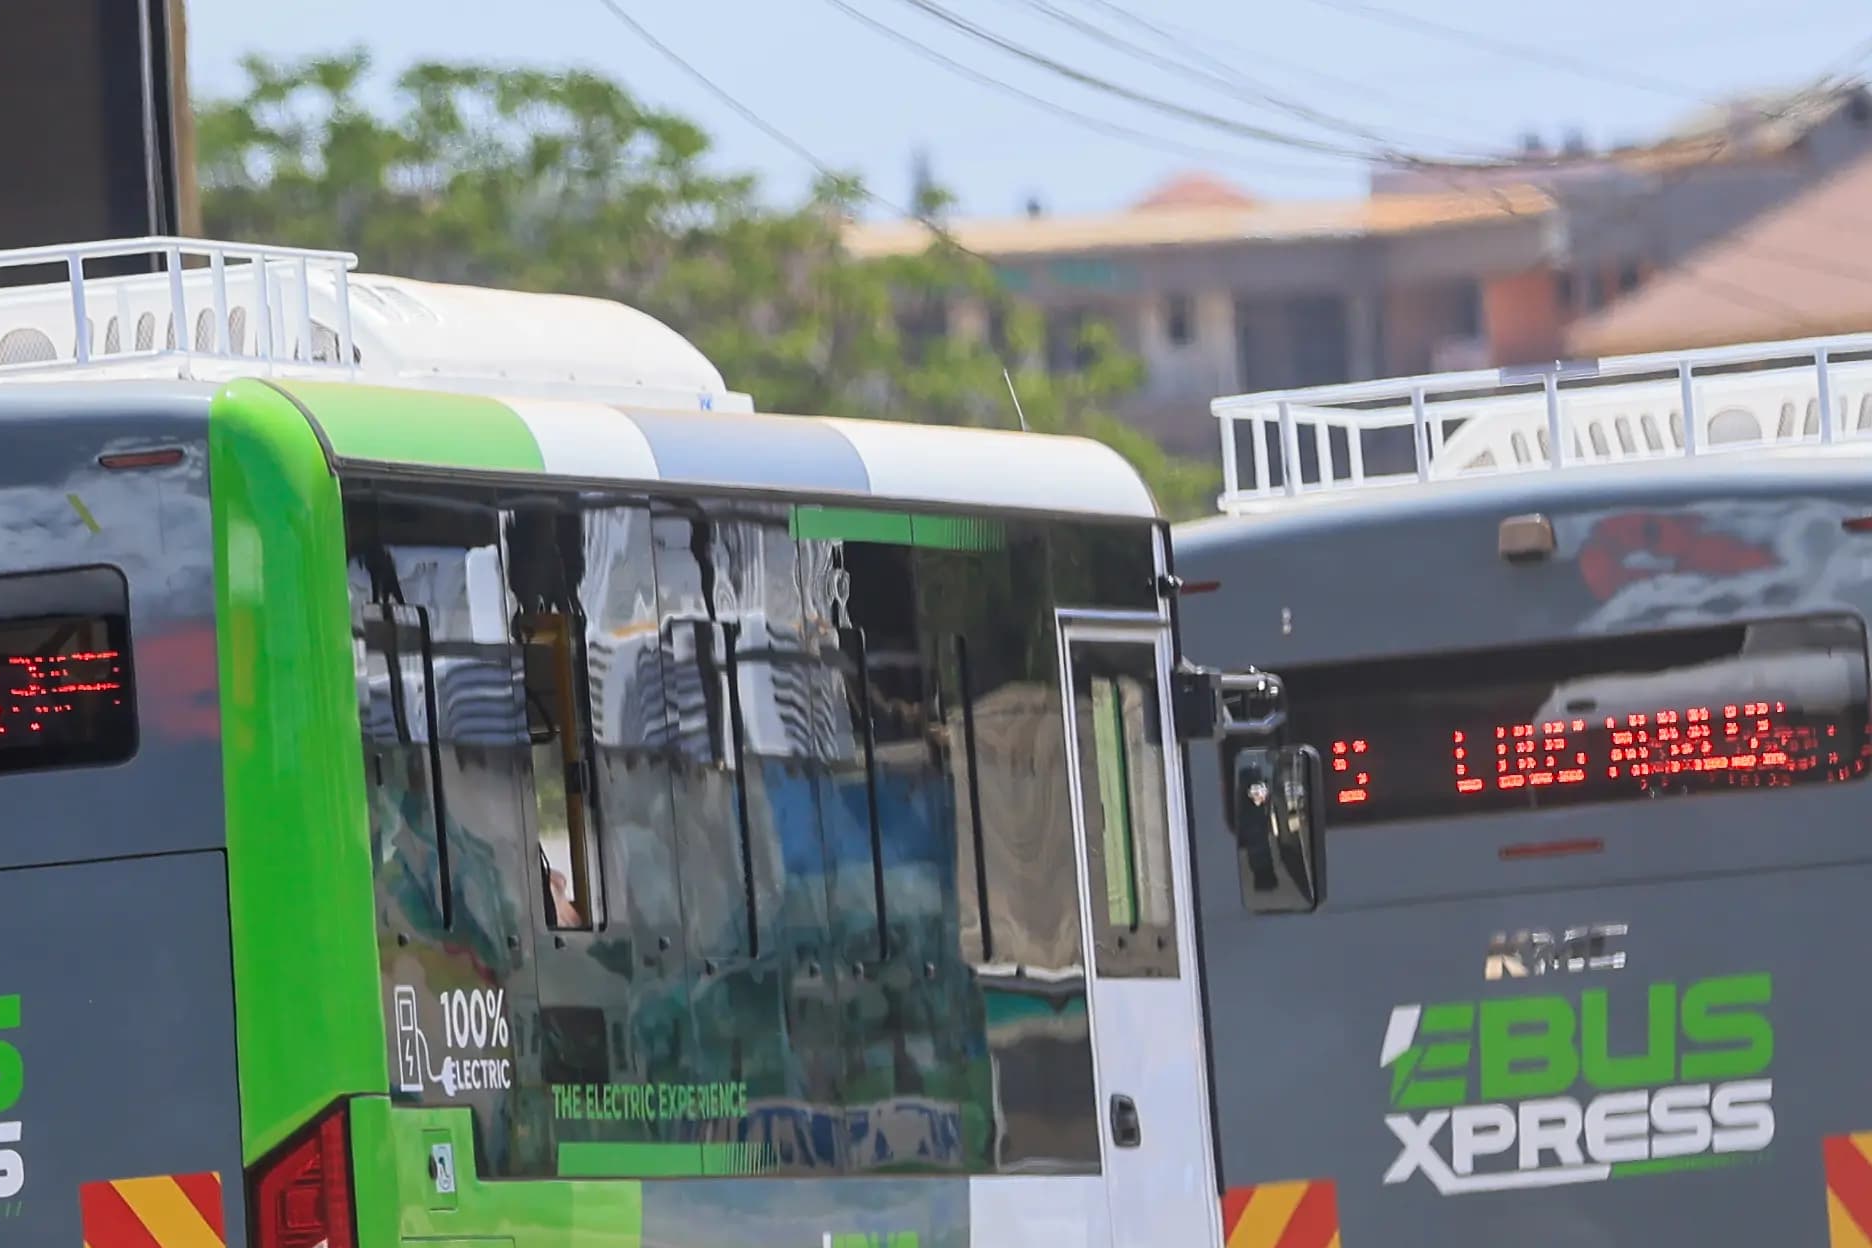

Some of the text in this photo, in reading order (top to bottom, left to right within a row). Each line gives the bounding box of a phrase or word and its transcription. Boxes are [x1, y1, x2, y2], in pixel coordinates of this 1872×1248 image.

[1484, 923, 1628, 981] KMC
[440, 989, 509, 1049] 100%
[1379, 972, 1774, 1108] EBUS
[441, 1056, 512, 1096] ELECTRIC
[551, 1080, 748, 1120] THE ELECTRIC EXPERIENCE
[1382, 1078, 1776, 1195] XPRESS
